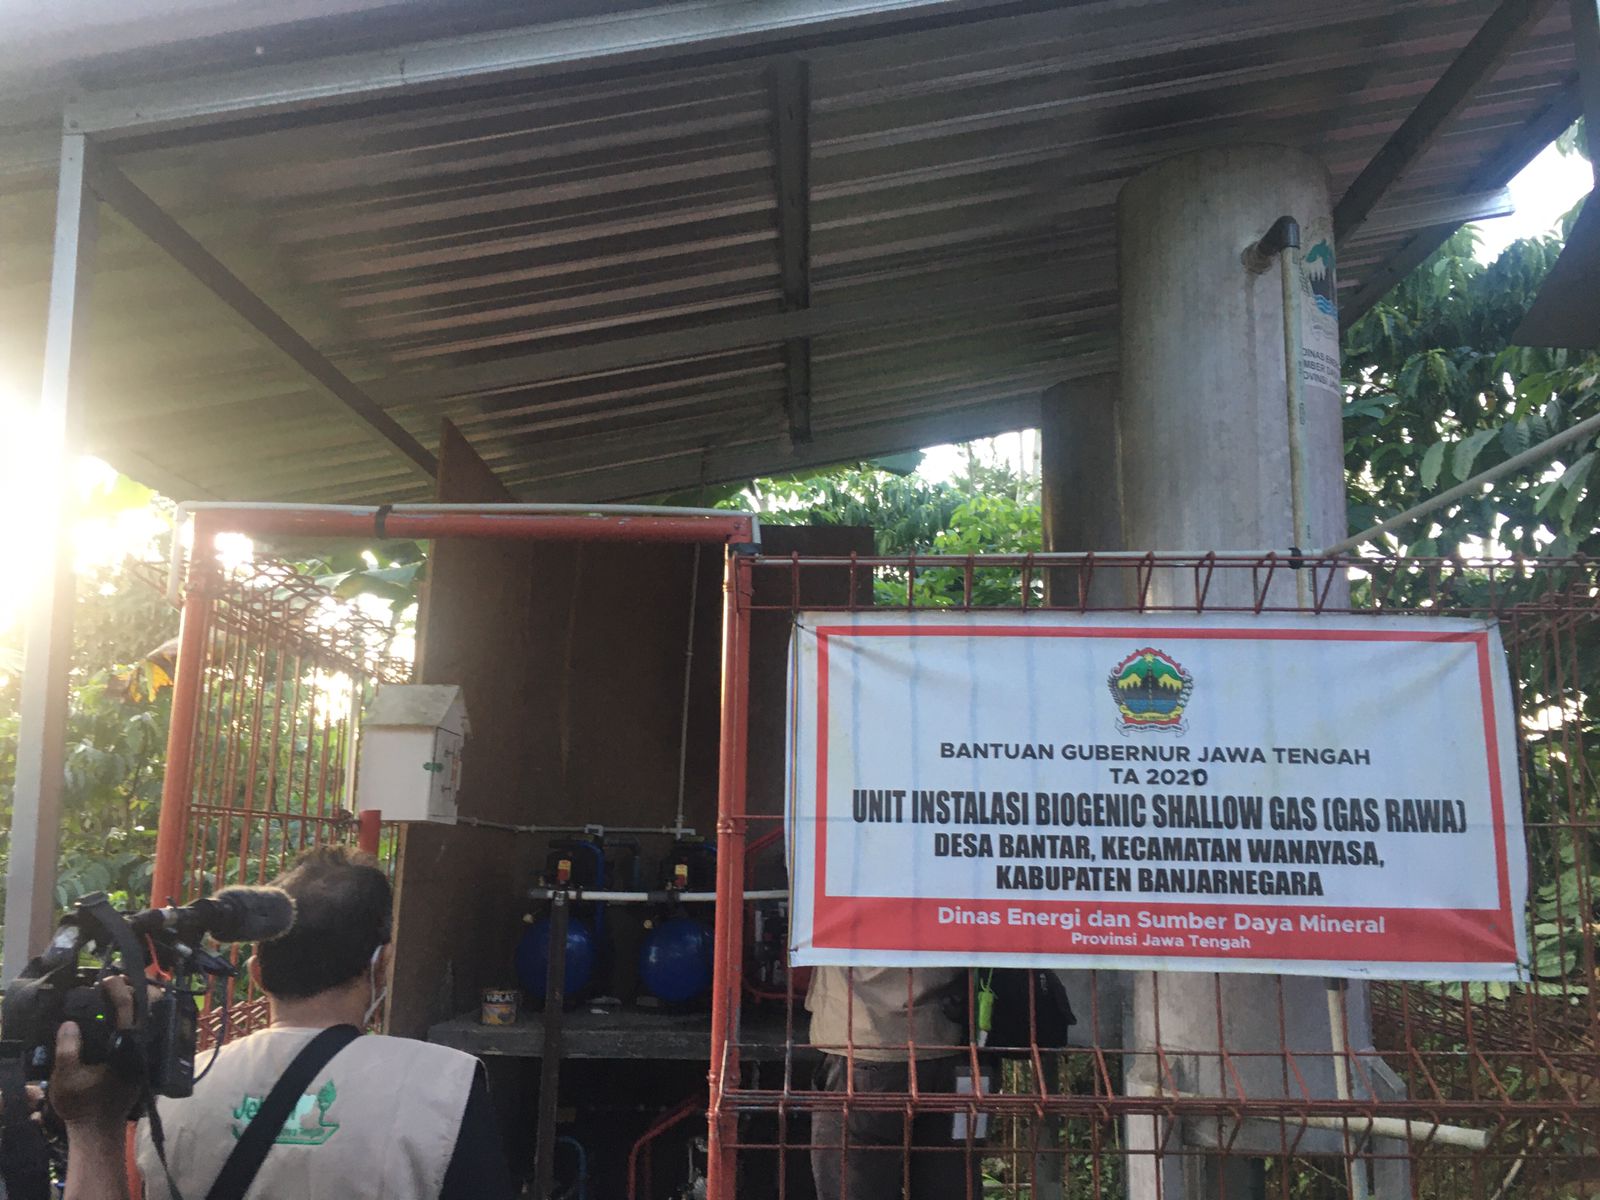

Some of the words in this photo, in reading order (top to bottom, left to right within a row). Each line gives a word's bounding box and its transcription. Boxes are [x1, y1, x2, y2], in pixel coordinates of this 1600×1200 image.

[1303, 360, 1325, 372] MBER
[940, 742, 1054, 760] BANTUAN
[1061, 744, 1191, 762] GUBERNUR
[1198, 746, 1266, 764] JAWA
[1272, 747, 1371, 765] TENGAH
[1109, 768, 1140, 785] TA
[1146, 768, 1209, 787] 2020
[852, 789, 906, 824] UNIT
[911, 790, 1029, 826] INSTALASI
[1035, 792, 1147, 828] BIOGENIC
[1151, 793, 1263, 830] SHALLOW
[1269, 795, 1318, 832] GAS
[934, 832, 994, 858] DESA
[999, 833, 1096, 862] BANTAR,
[1101, 835, 1242, 862] KECAMATAN
[1246, 838, 1385, 868] WANAYASA,
[996, 865, 1132, 892] KABUPATEN
[1137, 867, 1324, 895] BANJARNEGARA
[938, 905, 1001, 925] Dinas
[1007, 907, 1081, 930] Energi
[1087, 909, 1131, 928] dan
[1137, 910, 1227, 930] Sumber
[1234, 913, 1293, 935] Daya
[1300, 914, 1385, 934] Mineral
[1071, 932, 1138, 946] Provinsi
[1142, 934, 1185, 947] Jawa
[1188, 934, 1251, 951] Tengah
